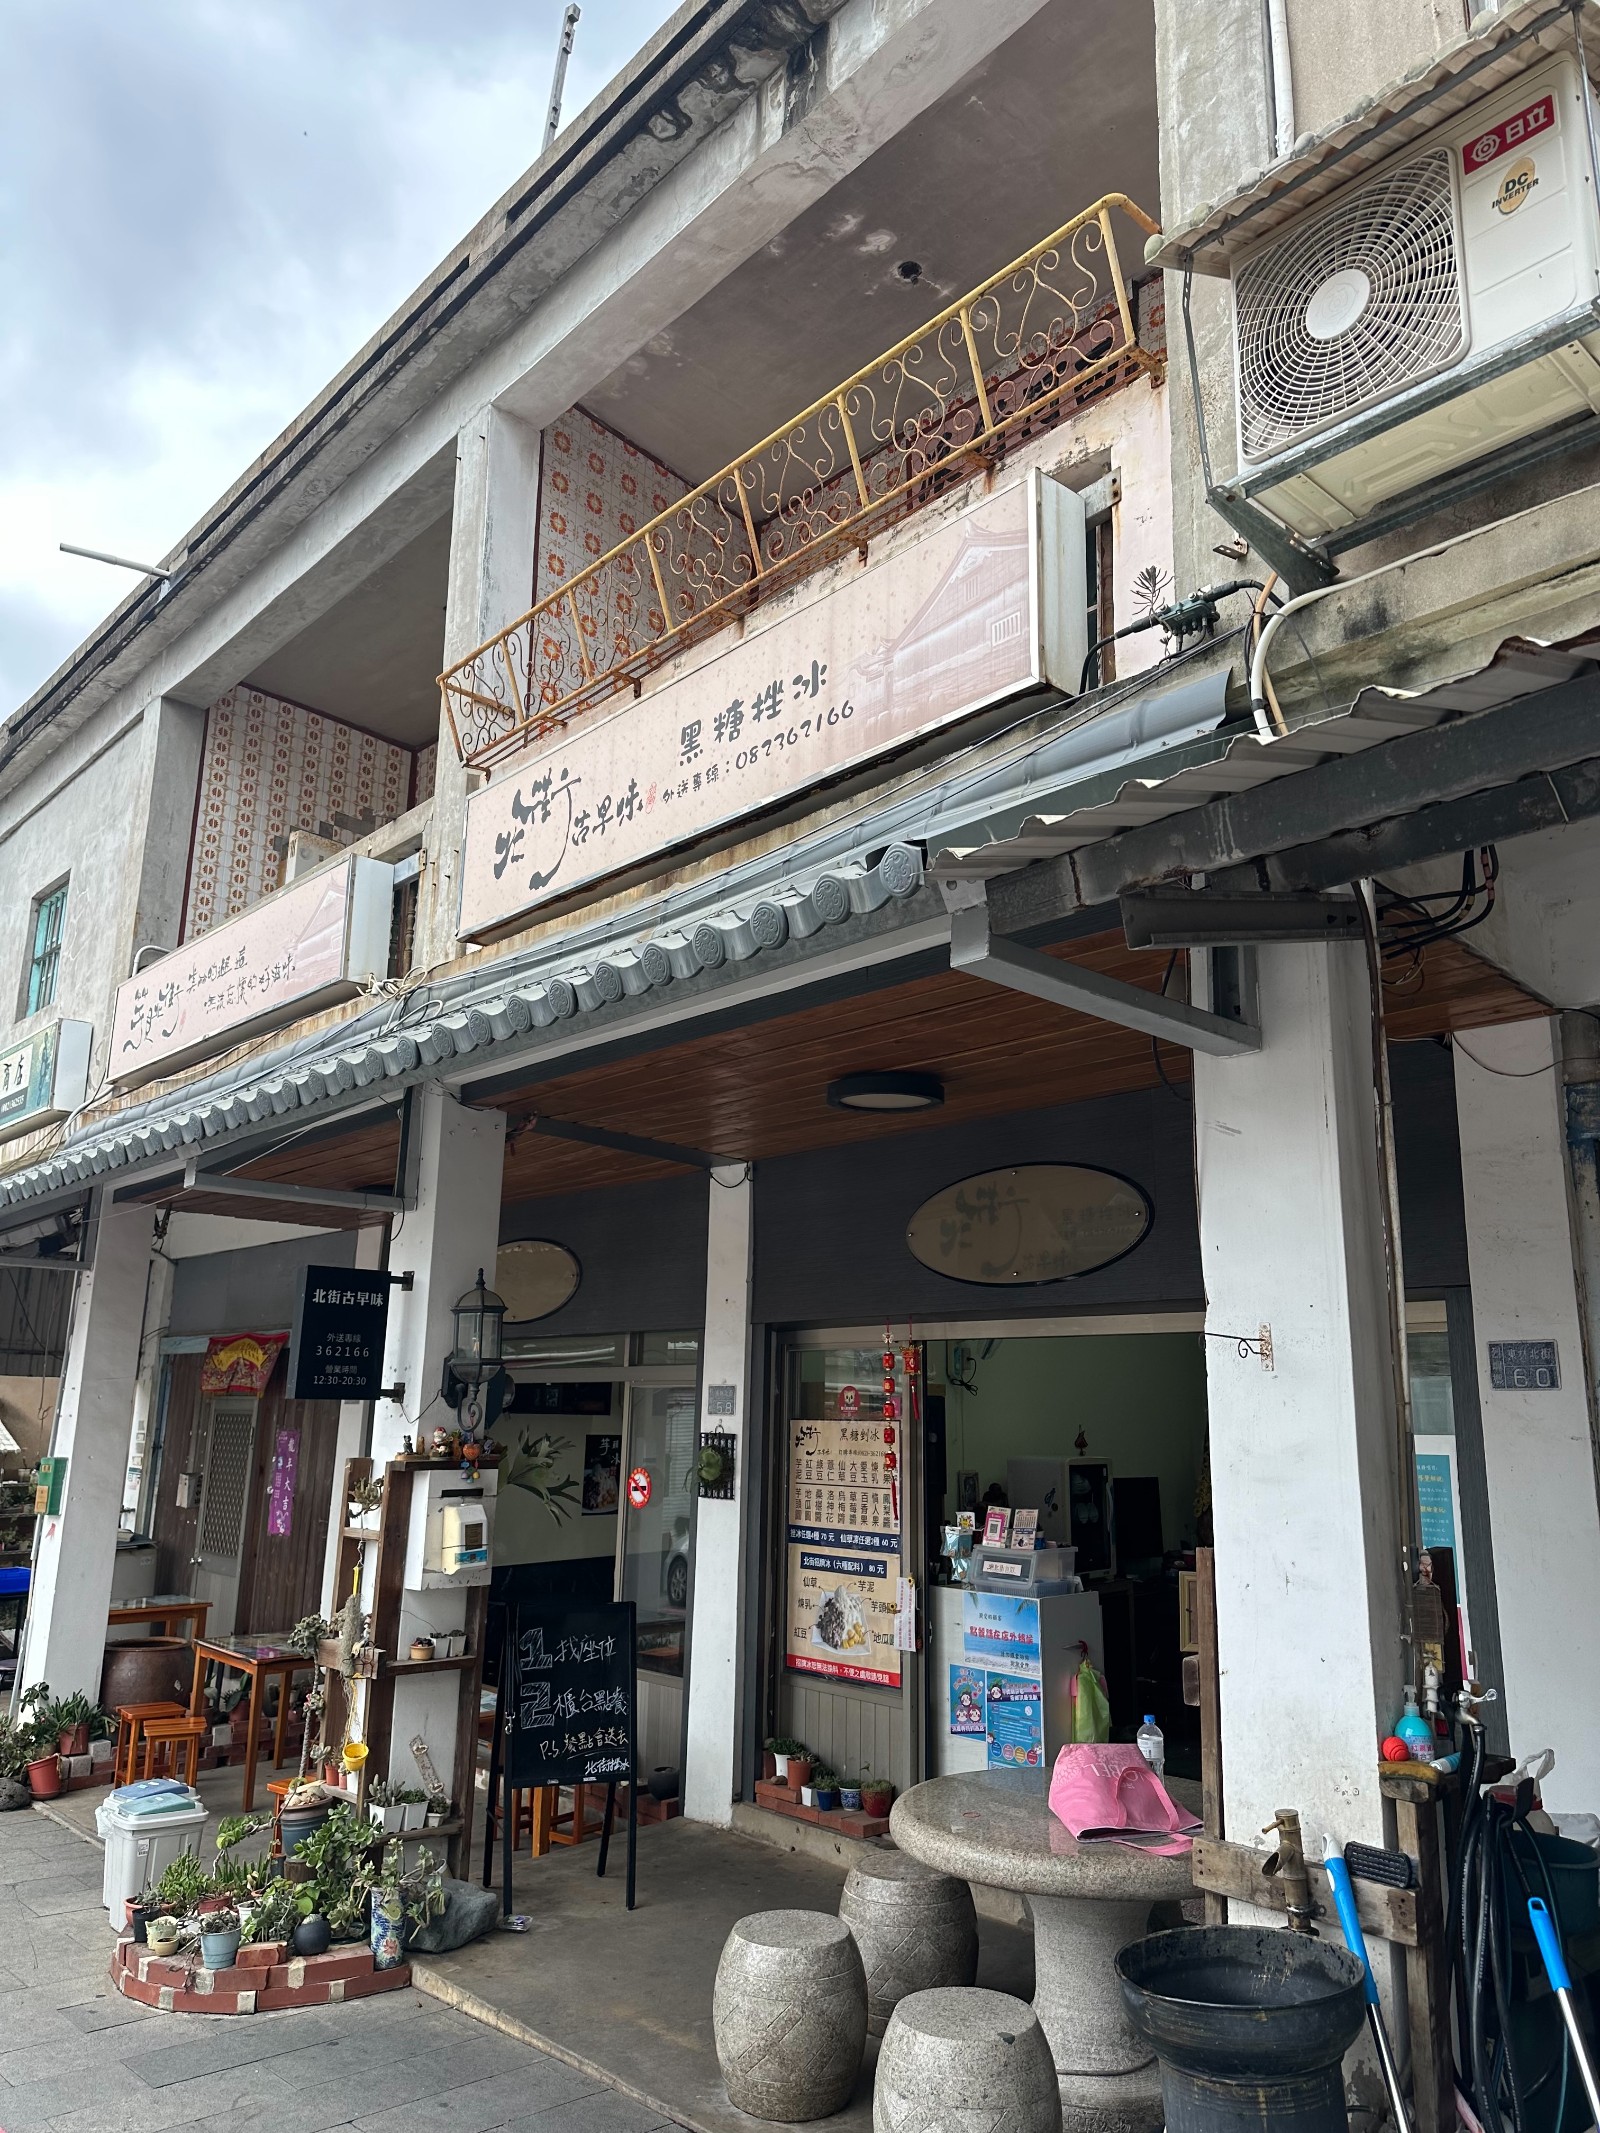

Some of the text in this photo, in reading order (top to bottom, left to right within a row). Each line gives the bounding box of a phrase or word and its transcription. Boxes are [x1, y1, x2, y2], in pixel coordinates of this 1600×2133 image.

[1505, 105, 1548, 144] 日立
[1491, 178, 1539, 209] INVERTER
[1504, 172, 1529, 194] DC
[680, 660, 827, 766] 黑糖挫冰
[312, 1288, 384, 1307] 北街古早味
[313, 1375, 367, 1386] 12:30-20:30
[1513, 1368, 1551, 1388] 60
[805, 1459, 813, 1480] 紅豆
[838, 1460, 846, 1482] 仙草
[849, 1461, 858, 1483] 大豆
[860, 1461, 868, 1484] 愛玉
[860, 1492, 869, 1526] 百香果
[828, 1532, 835, 1542] 元
[890, 1538, 898, 1548] 元
[876, 1564, 885, 1575] 元
[802, 1576, 818, 1588] 仙草
[857, 1580, 875, 1593] 芋泥
[793, 1627, 807, 1640] 紅豆
[520, 1627, 617, 1671] 1 找座位
[519, 1681, 629, 1730] 2 櫃台點餐
